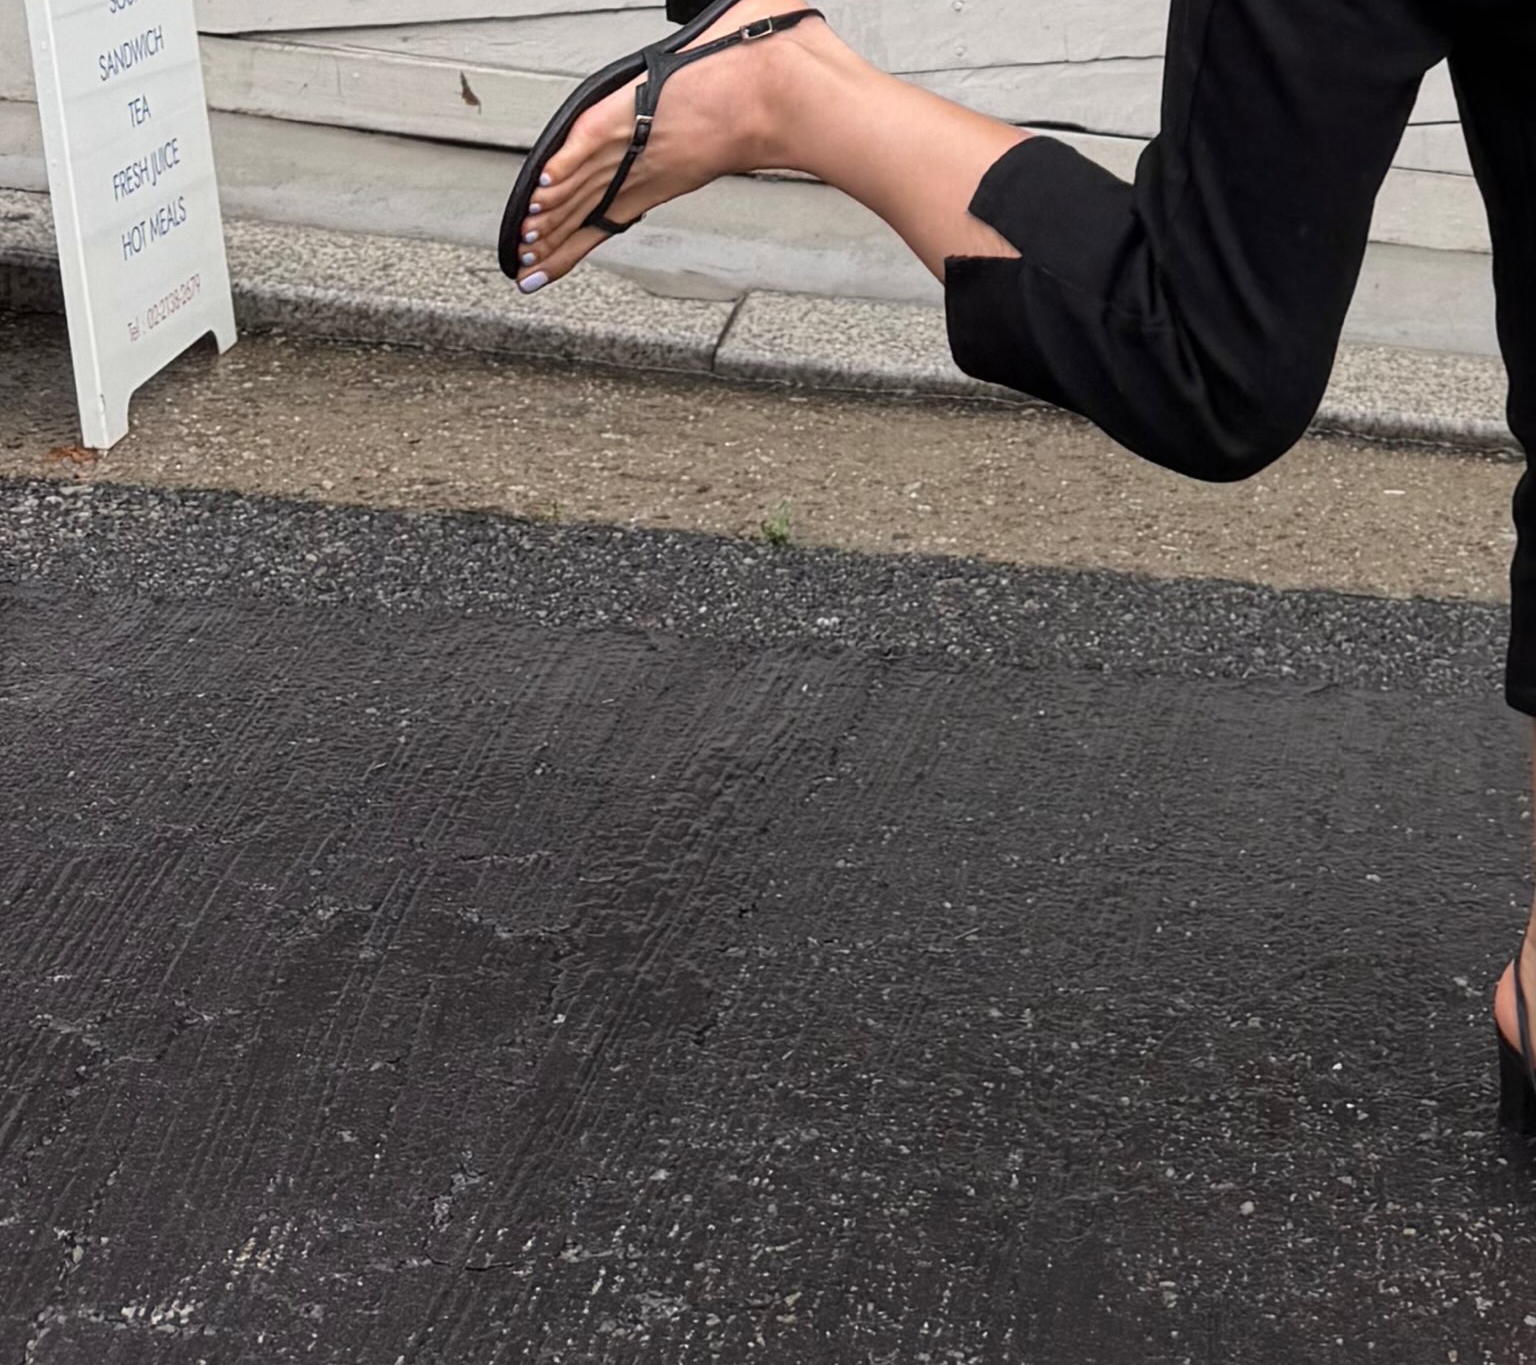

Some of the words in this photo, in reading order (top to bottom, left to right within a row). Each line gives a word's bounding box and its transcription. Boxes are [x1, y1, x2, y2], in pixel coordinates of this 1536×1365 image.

[98, 24, 165, 82] SANDWICH
[127, 93, 152, 128] TEA
[112, 156, 150, 202] FRESH
[150, 138, 181, 187] JUICE
[121, 220, 147, 262] HOT
[149, 195, 187, 243] MEALS
